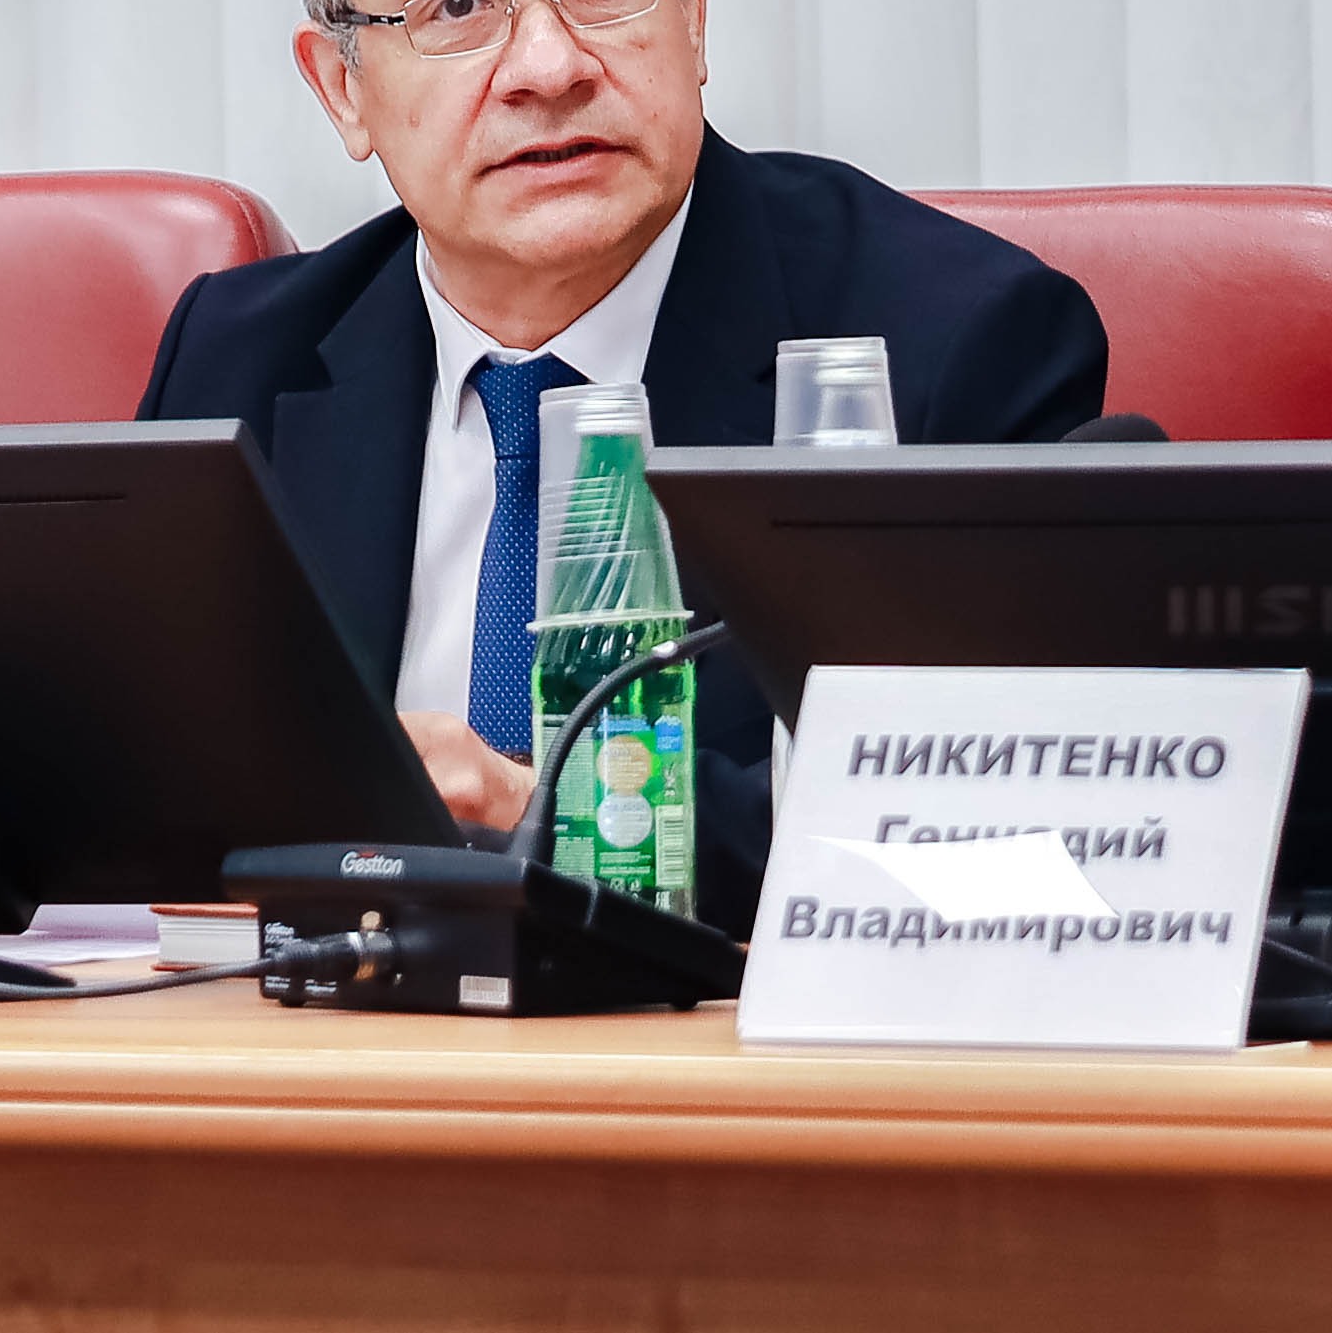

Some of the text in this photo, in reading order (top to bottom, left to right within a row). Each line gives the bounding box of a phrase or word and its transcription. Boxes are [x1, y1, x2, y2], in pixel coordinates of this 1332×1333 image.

[846, 734, 1227, 779] НИКИТЕНКО
[875, 815, 1168, 865] Гедий
[780, 895, 1234, 952] Владимирович
